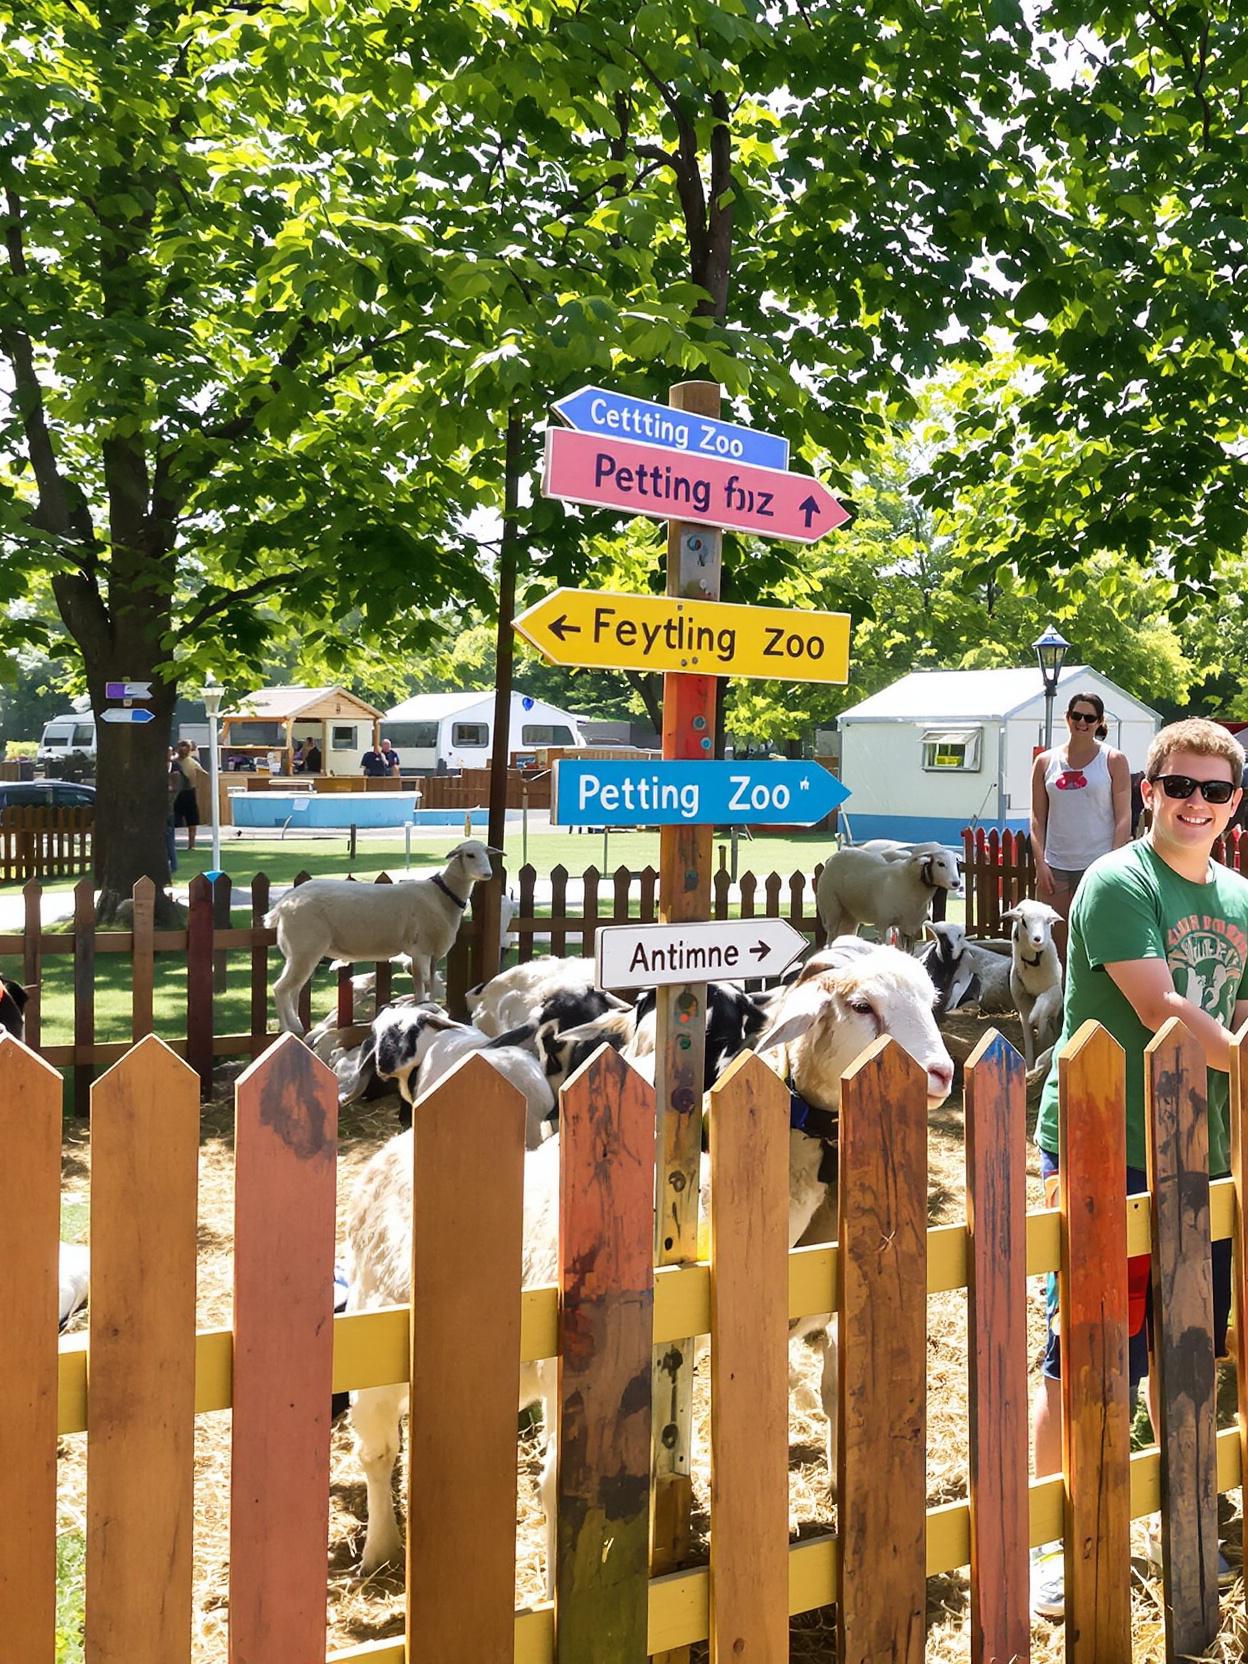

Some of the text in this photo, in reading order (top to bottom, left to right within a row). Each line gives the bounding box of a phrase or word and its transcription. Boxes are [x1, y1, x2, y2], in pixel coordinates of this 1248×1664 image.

[699, 424, 744, 458] Zoo
[594, 452, 711, 513] Petting
[593, 607, 826, 660] Feytling Zoo
[578, 775, 791, 818] Petting Zoo
